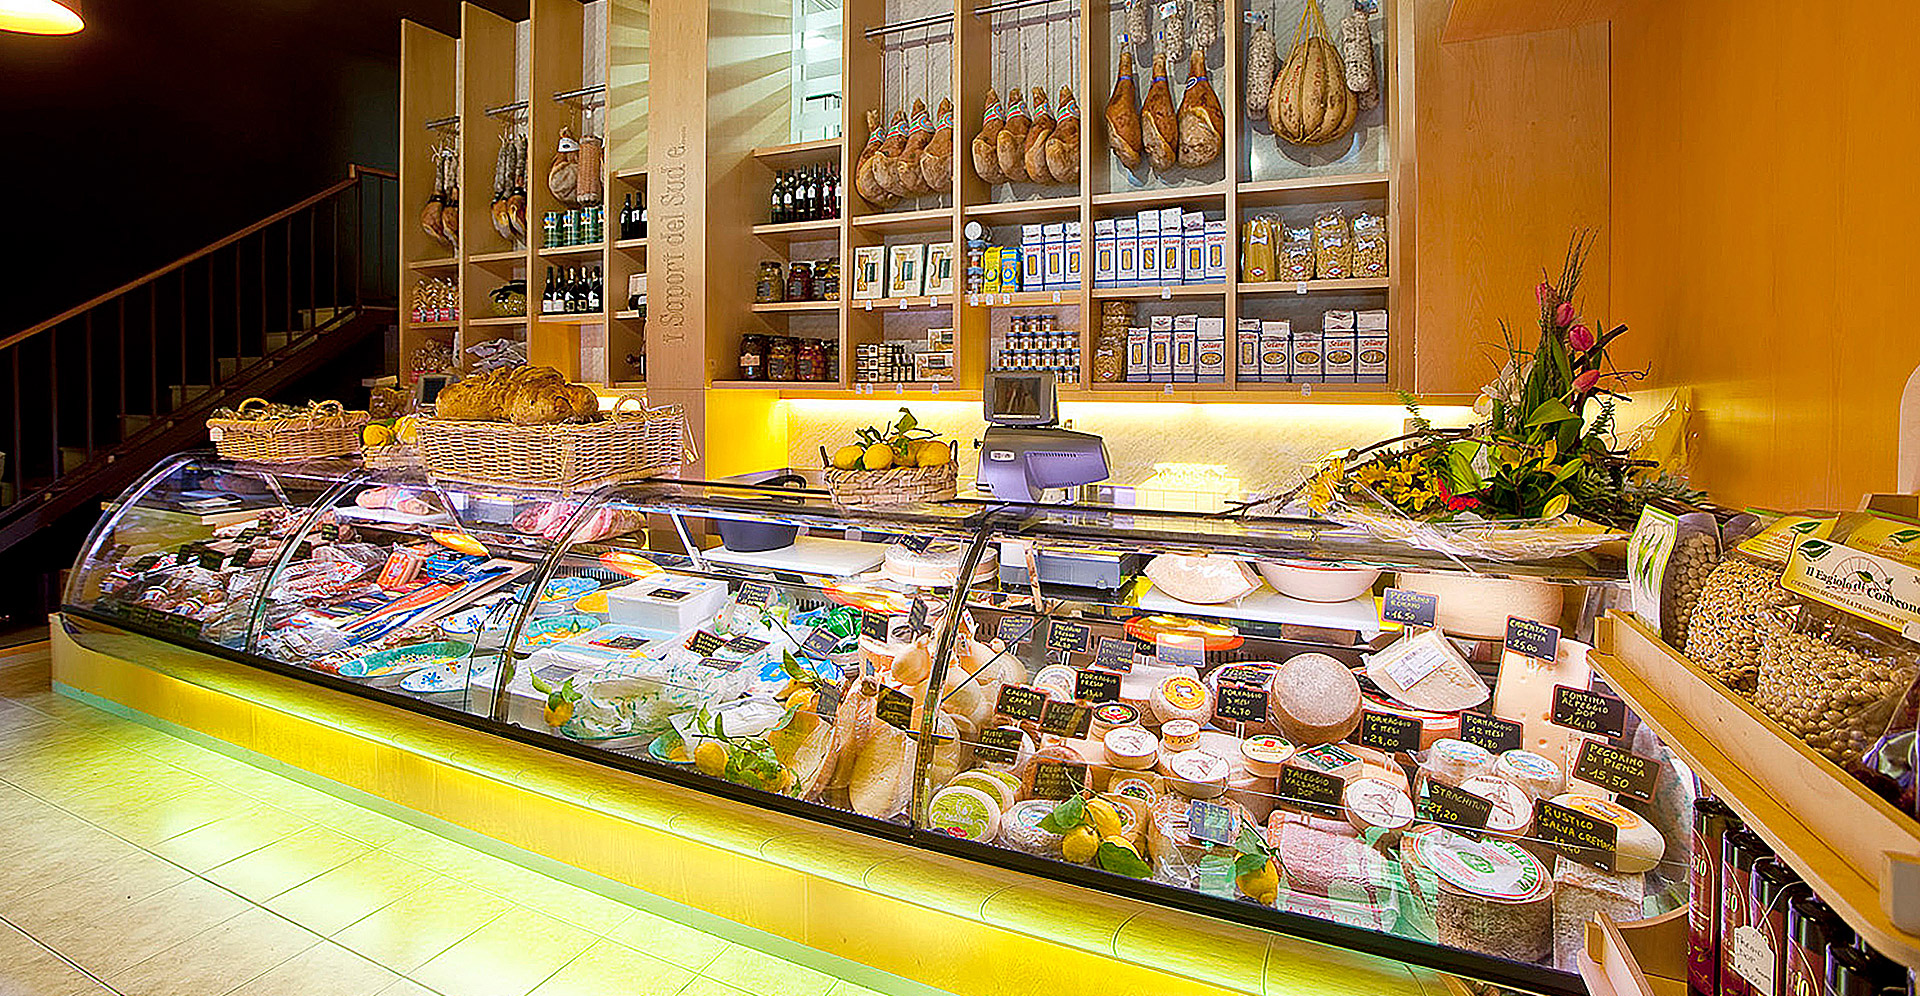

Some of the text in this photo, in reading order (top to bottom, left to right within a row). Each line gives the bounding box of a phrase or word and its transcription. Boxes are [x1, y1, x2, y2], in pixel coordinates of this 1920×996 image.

[658, 163, 686, 206] Sud
[659, 212, 686, 246] del
[658, 252, 691, 327] Sapori
[1805, 566, 1815, 577] Il
[1854, 580, 1866, 592] di
[1585, 752, 1646, 778] DI PIENZA
[1589, 743, 1646, 768] PECORINO
[1286, 768, 1330, 787] TALEGGIO
[1543, 804, 1595, 831] RUSTICO
